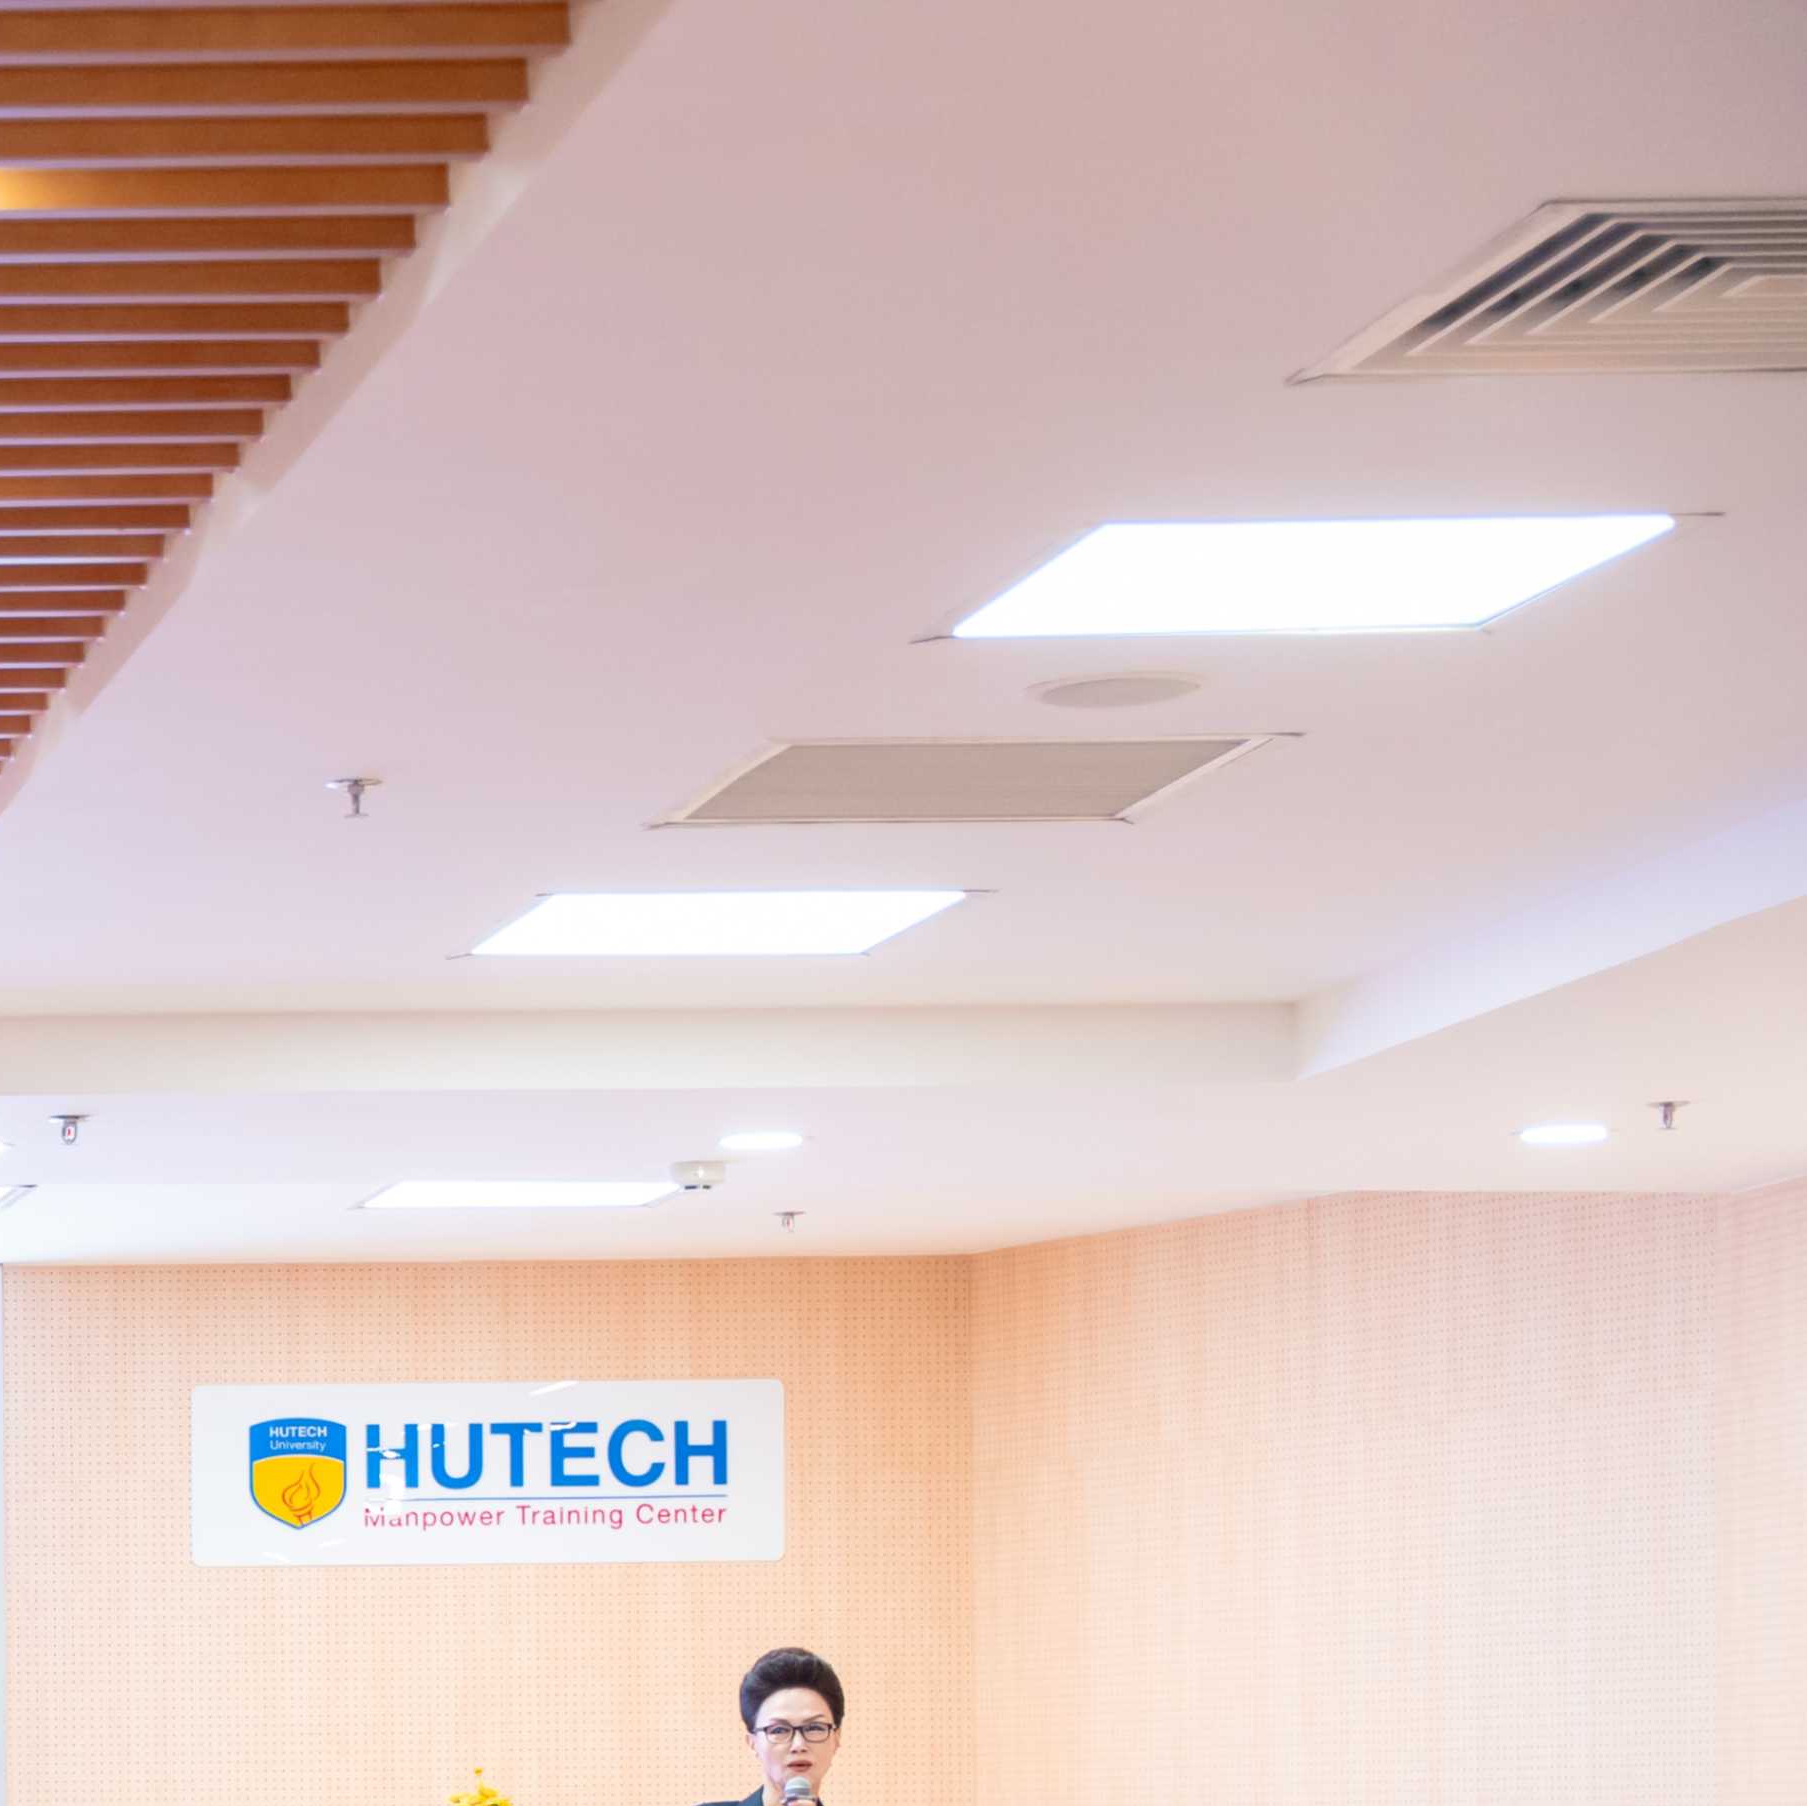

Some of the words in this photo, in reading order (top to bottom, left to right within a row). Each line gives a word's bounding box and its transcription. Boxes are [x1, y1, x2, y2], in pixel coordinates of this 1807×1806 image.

[269, 1426, 328, 1438] HUTECH
[269, 1439, 327, 1452] University
[365, 1419, 729, 1489] HUTECH
[364, 1505, 507, 1530] Manpower
[516, 1503, 624, 1530] Training
[635, 1503, 727, 1526] Center
